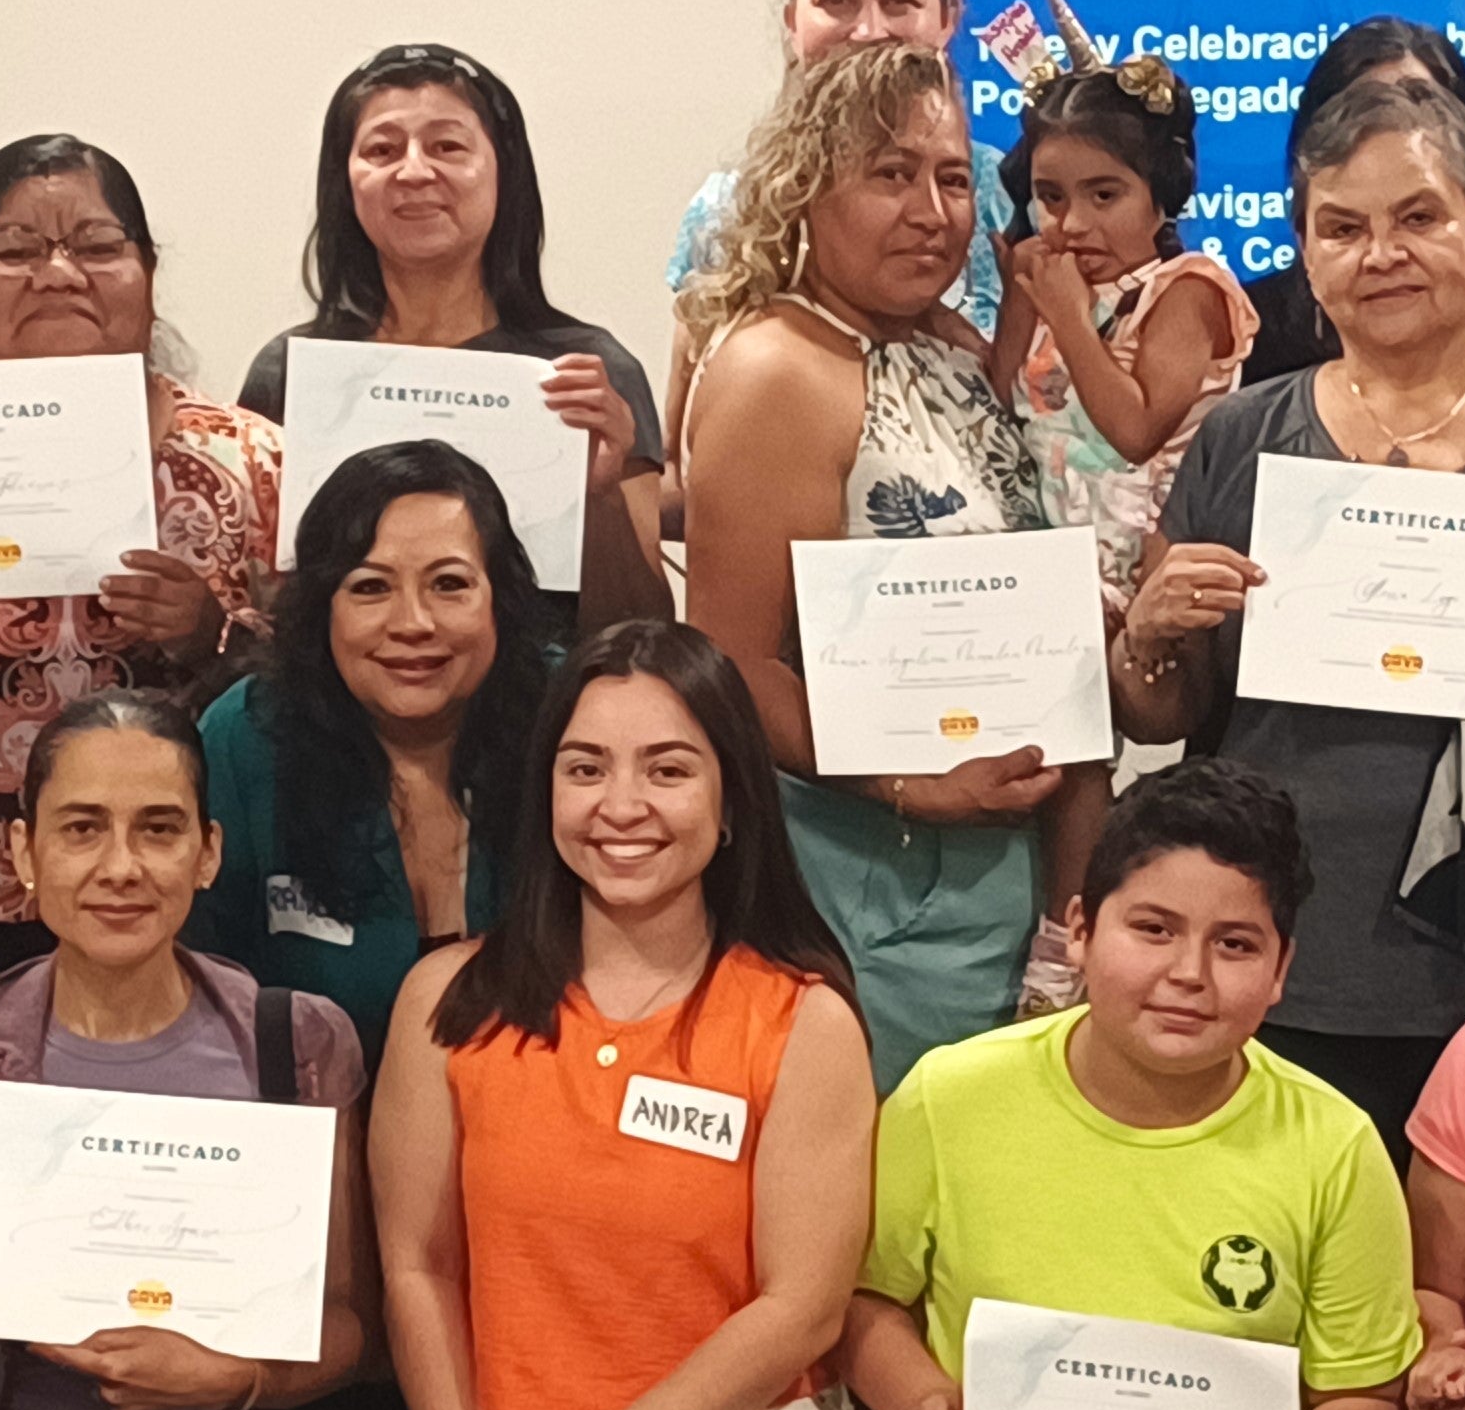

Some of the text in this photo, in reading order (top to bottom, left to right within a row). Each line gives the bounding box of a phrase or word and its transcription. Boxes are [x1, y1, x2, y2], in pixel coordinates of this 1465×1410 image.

[1132, 23, 1350, 62] Celebraci
[369, 385, 510, 409] CERTIFICADO
[876, 576, 1018, 596] CERTIFICADO
[632, 1096, 732, 1146] ANDREA
[81, 1136, 242, 1162] CERTIFICADO
[1054, 1358, 1212, 1392] CERTIFICADO
